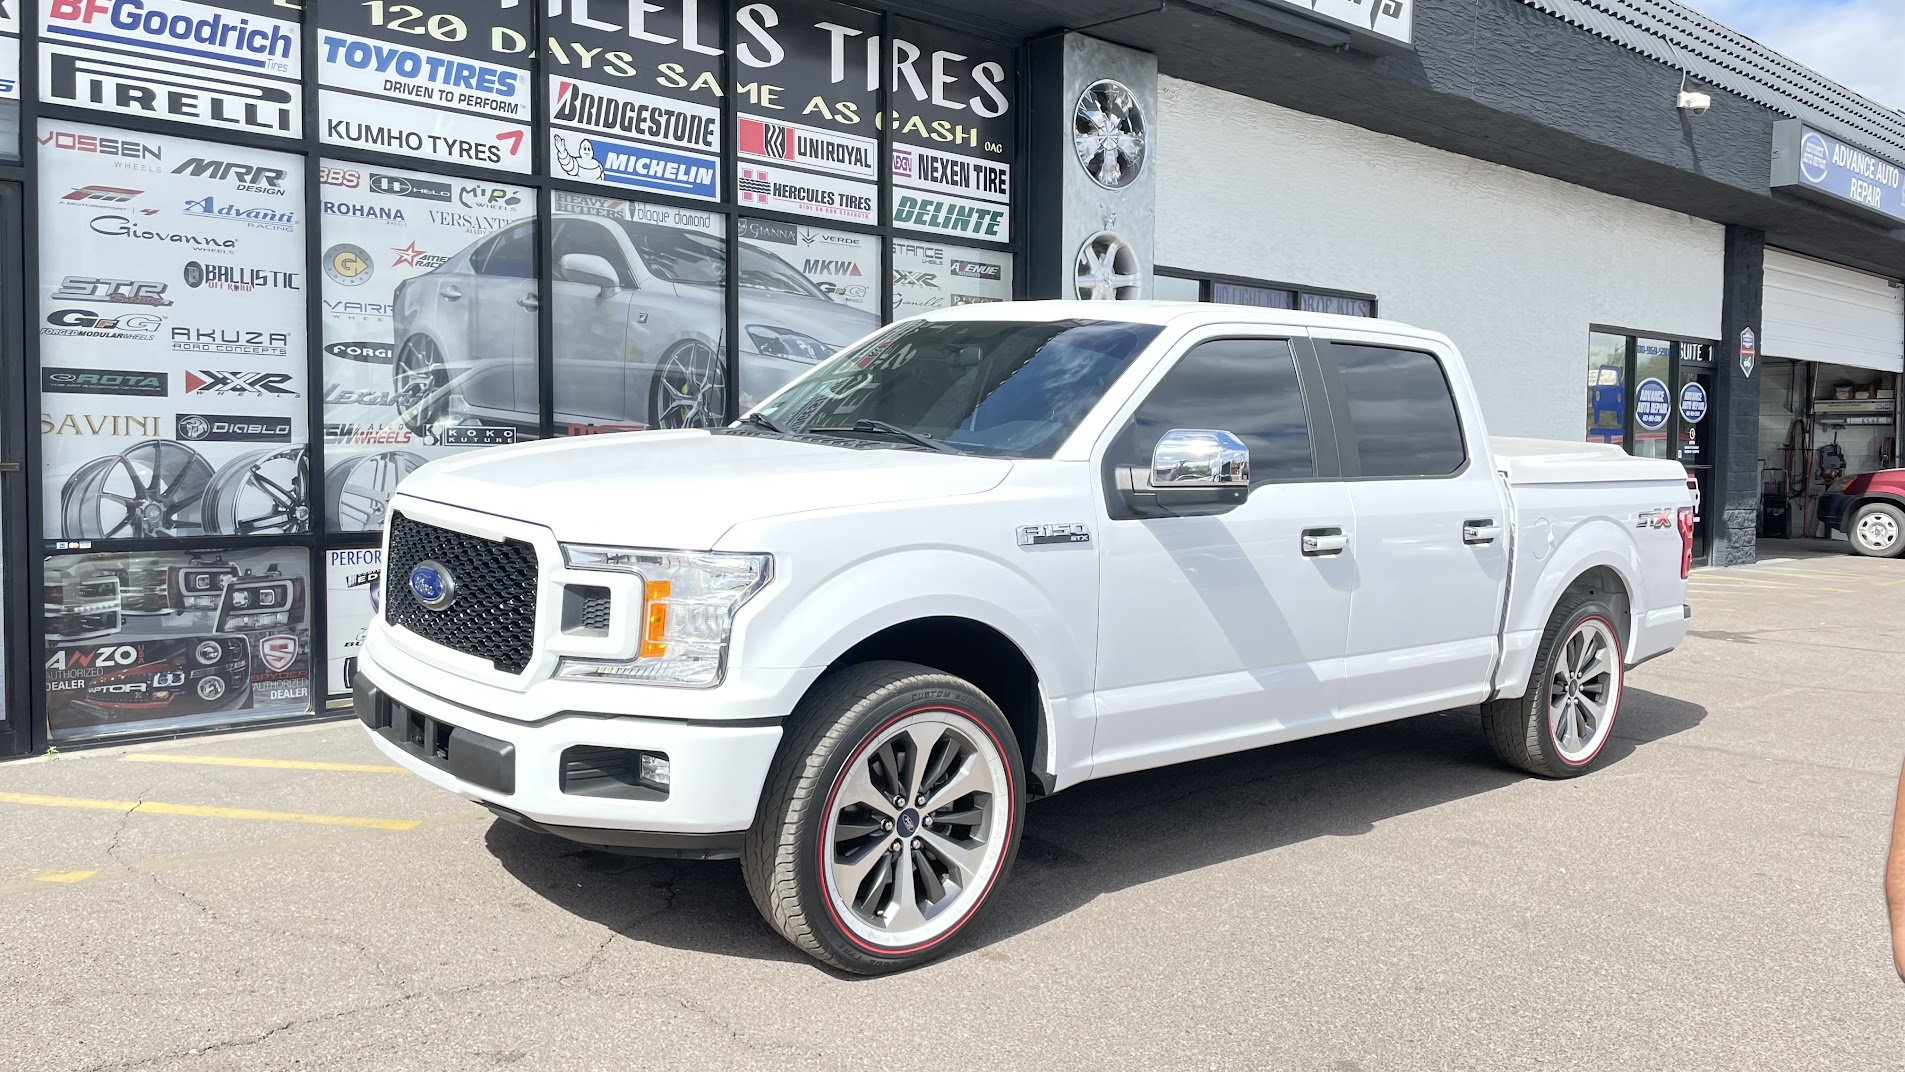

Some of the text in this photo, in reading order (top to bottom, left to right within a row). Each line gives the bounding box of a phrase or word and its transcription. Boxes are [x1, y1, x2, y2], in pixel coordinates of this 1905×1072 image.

[50, 0, 292, 58] BFGoodrich
[265, 59, 288, 73] Tires
[361, 0, 468, 42] 120
[491, 26, 637, 77] DAYS
[656, 62, 785, 110] SAME
[802, 96, 861, 124] AS
[875, 110, 978, 147] CASH
[813, 21, 1009, 118] TIRES
[50, 52, 292, 132] PIRELLI
[383, 79, 519, 115] DRIVEN TO PERFORM
[553, 81, 716, 147] BRIDGESTONE
[37, 130, 162, 161] VOSSEN
[327, 118, 502, 164] KUMHO TYRES
[797, 135, 872, 169] UNIROYAL
[113, 161, 162, 174] WHEELS
[170, 157, 287, 188] MRR
[604, 151, 714, 186] MICHELIN
[918, 153, 1007, 195] NEXEN TIRE
[1832, 143, 1899, 189] ADVANCE AUTO
[236, 184, 286, 196] DESIGN
[772, 182, 872, 212] HERCULES TIRES
[1849, 177, 1881, 209] REPAIR
[183, 196, 294, 224] Advanti
[323, 201, 405, 221] ROHANA
[673, 208, 711, 229] diamond
[893, 196, 1005, 236] DELINTE
[89, 215, 236, 249] Giovanna
[247, 222, 294, 233] RACING
[749, 223, 796, 242] GIANNA
[822, 234, 860, 244] VERDE
[893, 242, 943, 259] STANCE
[204, 263, 300, 290] BALLISTIC
[802, 258, 852, 276] MKW
[171, 326, 287, 347] AKUZA
[216, 345, 287, 355] CONCEPTS
[1680, 342, 1703, 361] SUITE
[77, 373, 160, 387] ROTA
[41, 413, 161, 437] SAVINI
[212, 421, 290, 438] DIABLO
[448, 429, 513, 437] KOKO
[354, 431, 412, 444] WHEELS
[1636, 508, 1671, 530] STX
[45, 645, 138, 671] ANZO
[46, 667, 103, 679] AUTHORIZED
[251, 670, 308, 683] SPYDER
[46, 679, 85, 691] DEALER
[252, 678, 308, 691] AUTHORIZED
[271, 688, 308, 700] DEALER
